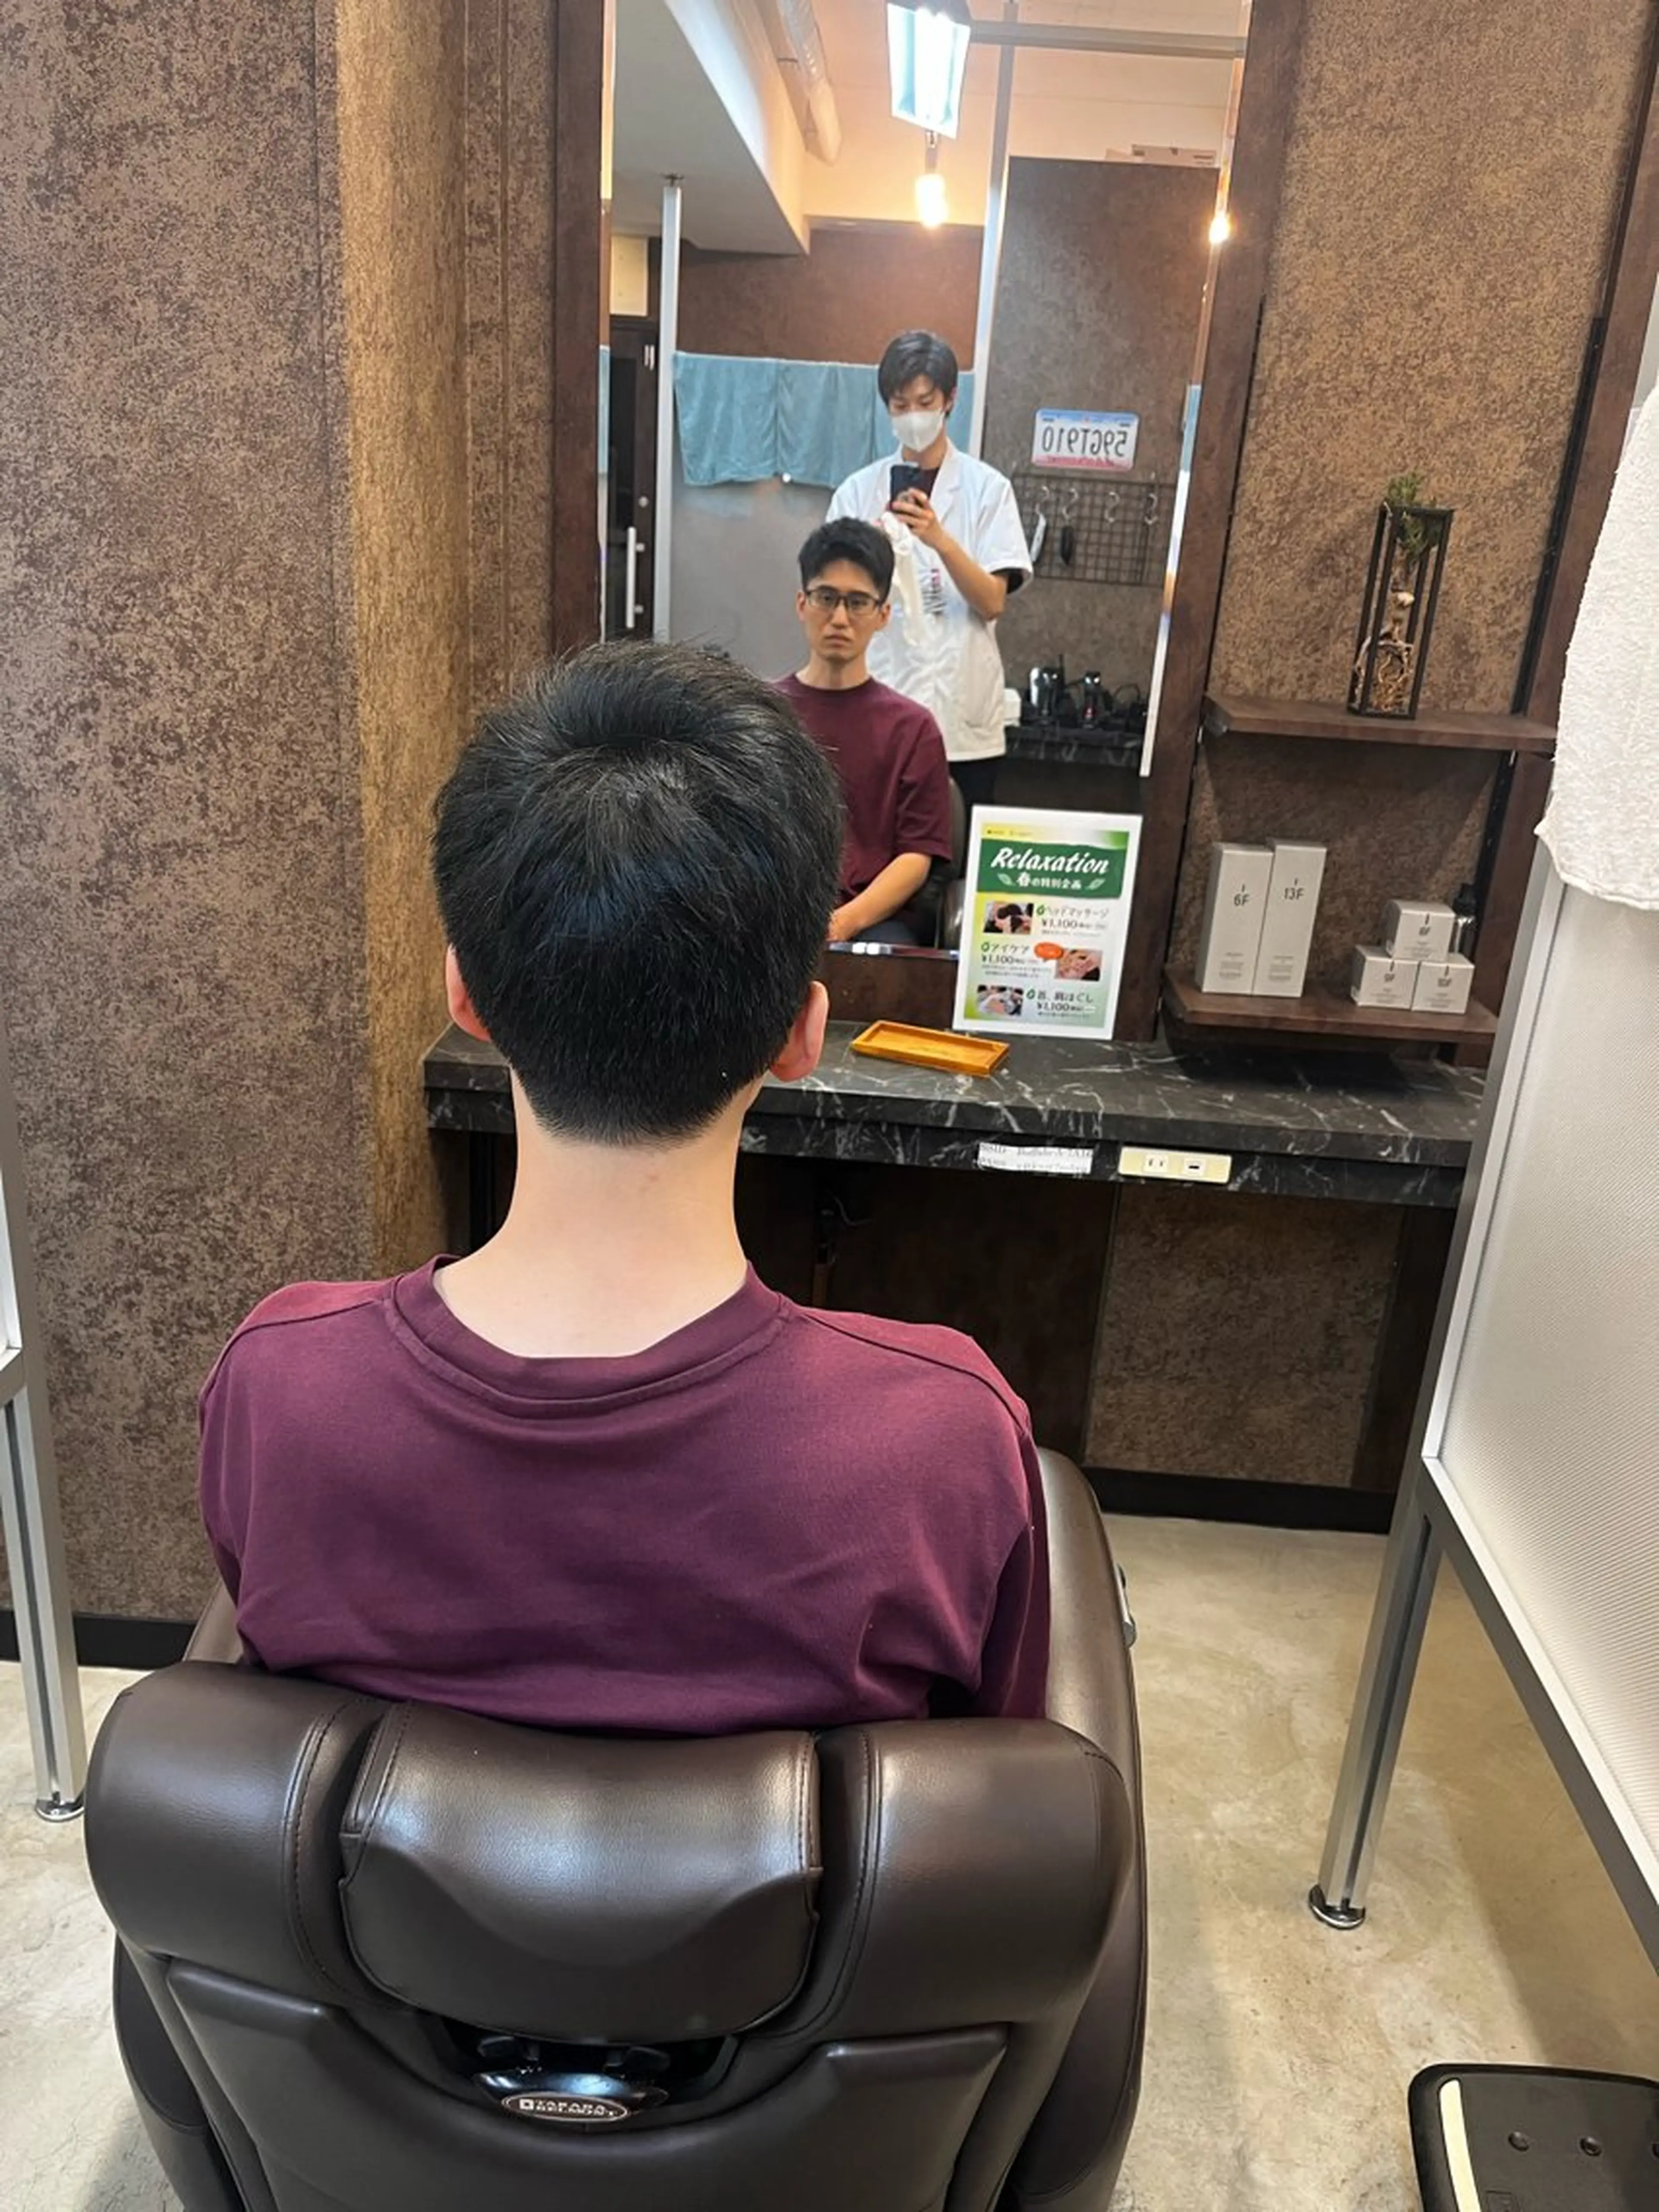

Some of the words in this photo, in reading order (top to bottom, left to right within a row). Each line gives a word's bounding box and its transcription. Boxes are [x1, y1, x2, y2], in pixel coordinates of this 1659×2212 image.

[991, 847, 1109, 874] Relaxation
[1233, 893, 1249, 906] 6F
[1284, 887, 1304, 900] 13F
